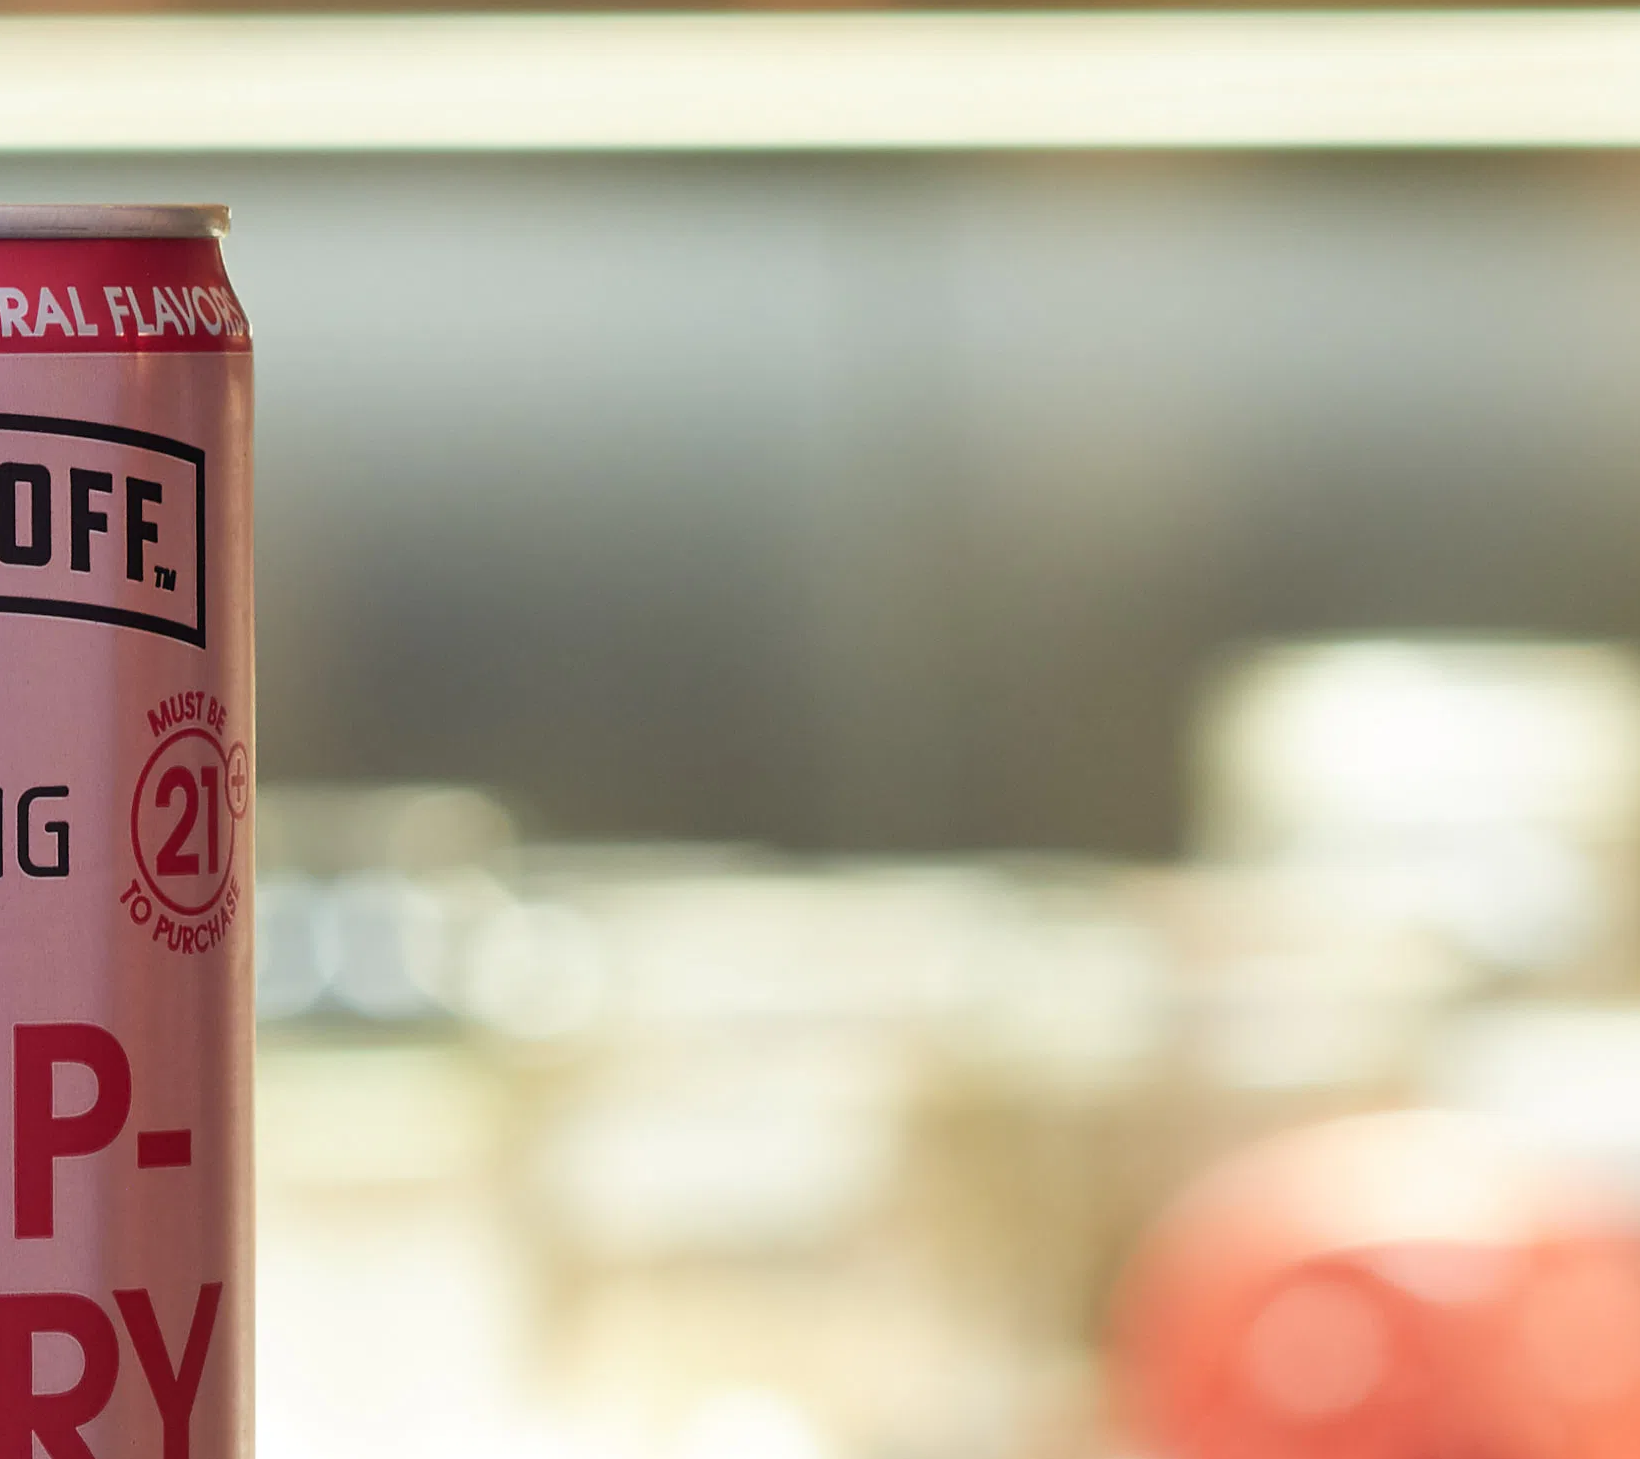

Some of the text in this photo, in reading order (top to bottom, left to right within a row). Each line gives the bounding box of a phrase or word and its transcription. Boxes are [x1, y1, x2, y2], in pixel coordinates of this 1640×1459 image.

[146, 691, 228, 738] MUST BE
[119, 874, 242, 955] TO PURCHASE
